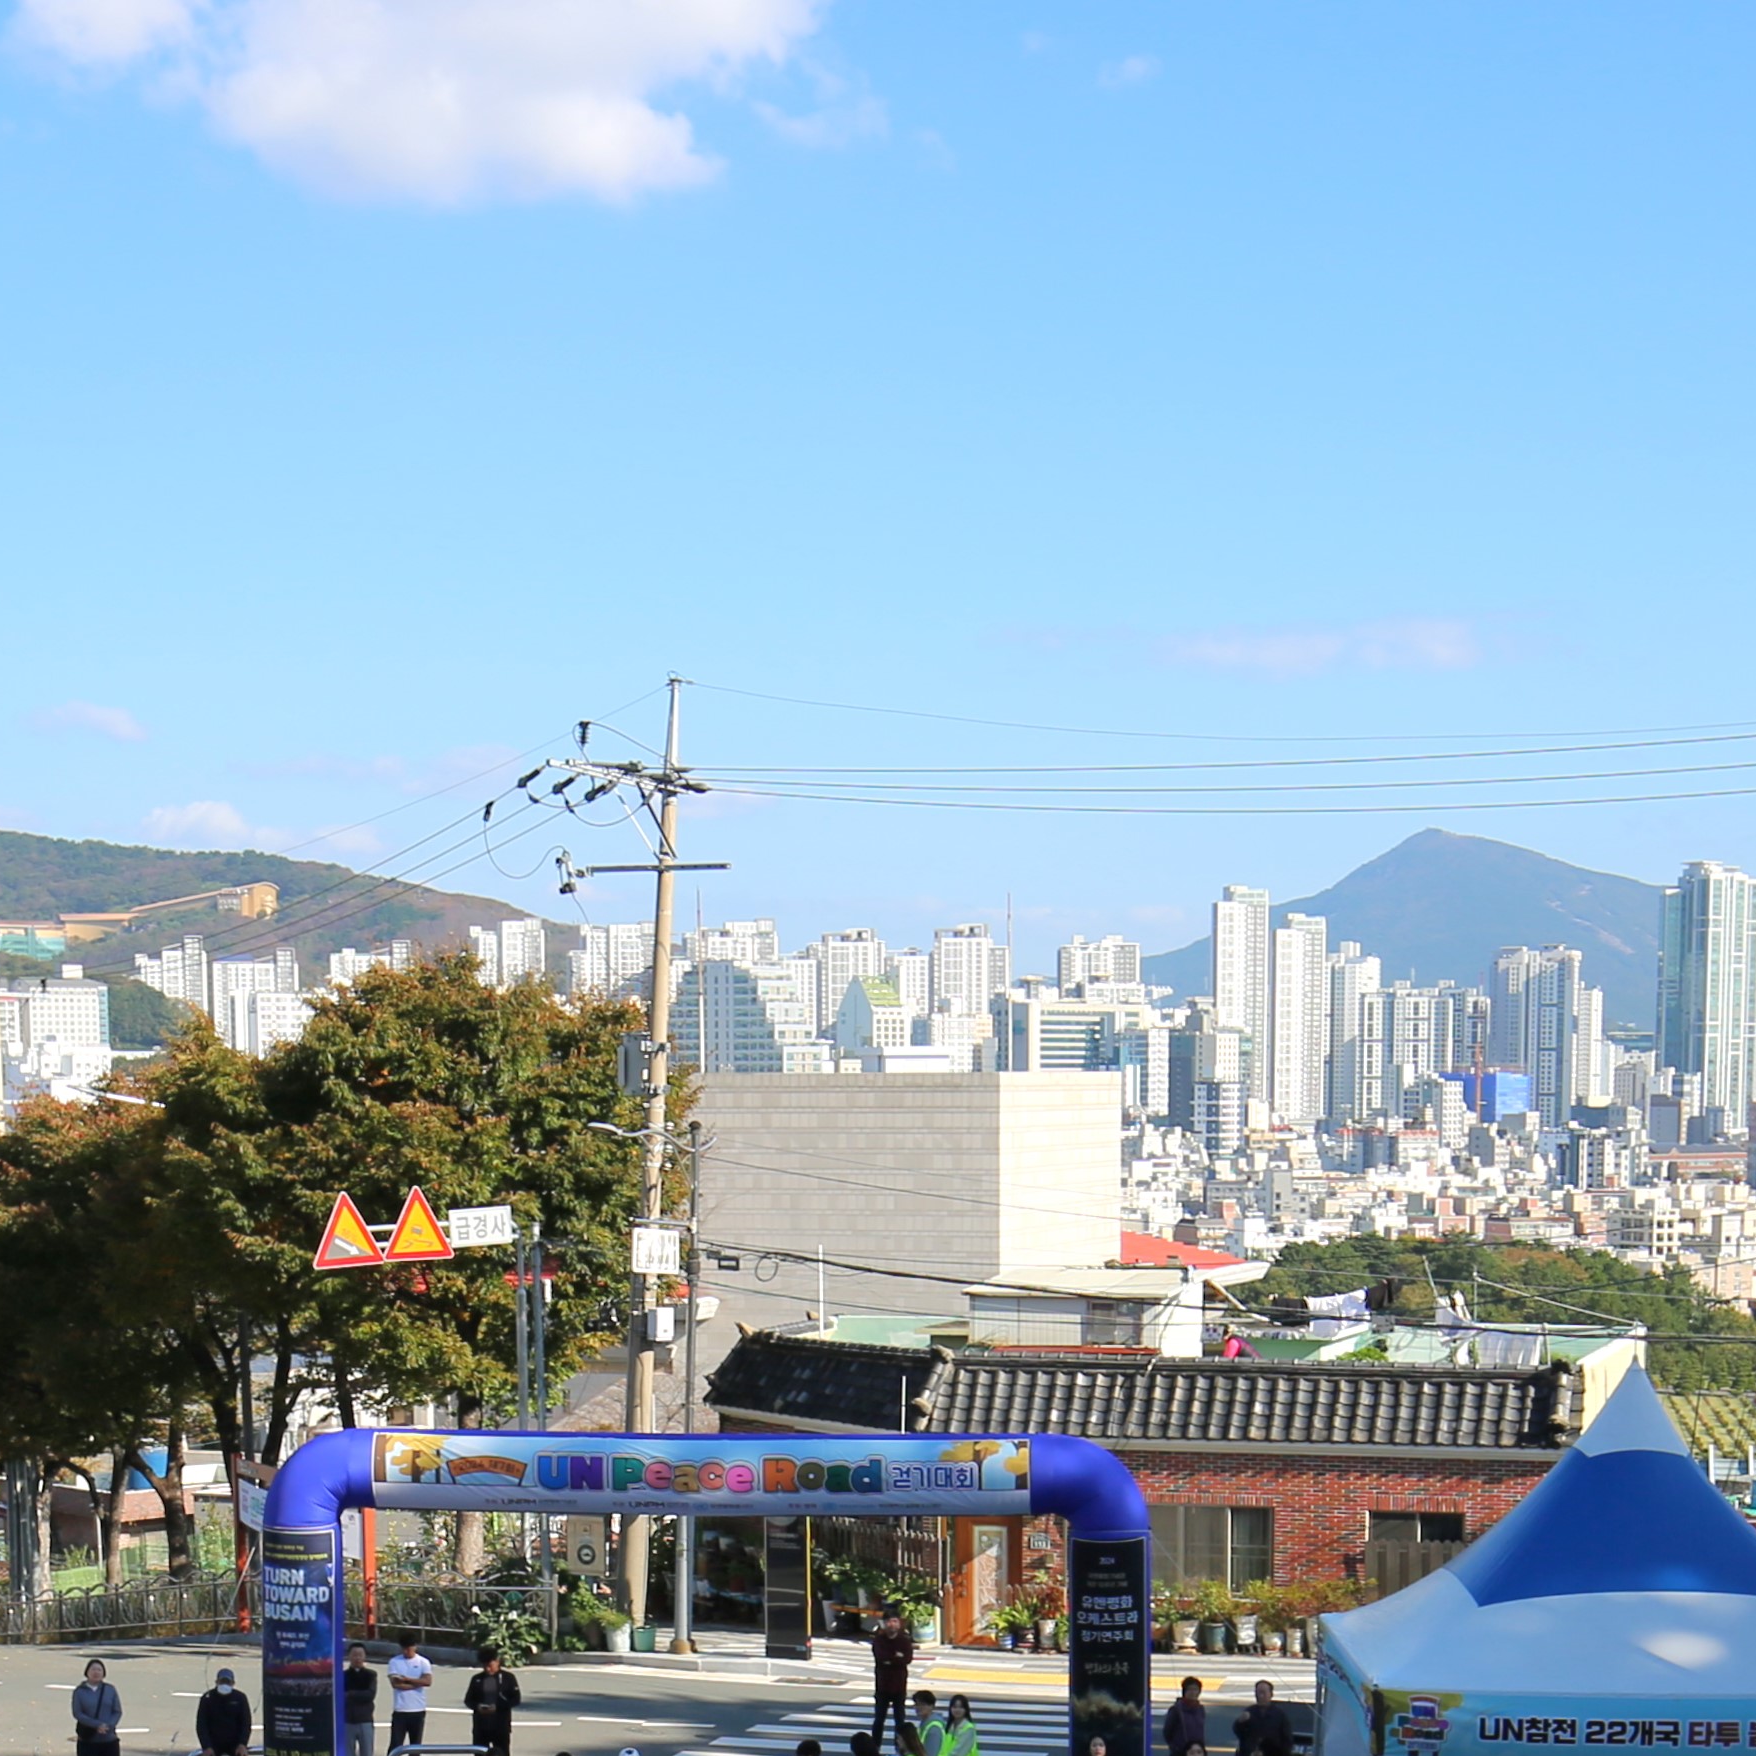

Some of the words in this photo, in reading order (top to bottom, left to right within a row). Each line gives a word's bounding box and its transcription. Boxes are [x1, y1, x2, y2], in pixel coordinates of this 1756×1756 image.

[455, 1213, 507, 1241] 급경사
[537, 1453, 604, 1491] UN
[610, 1453, 755, 1494] Peace
[762, 1455, 885, 1494] Road
[892, 1465, 974, 1490] 걷기대회
[264, 1566, 305, 1586] TURN
[265, 1584, 330, 1604] TOWARD
[1082, 1595, 1133, 1610] 유엔평화
[264, 1602, 317, 1621] BUSAN
[1076, 1611, 1139, 1625] 오케스트라
[1081, 1630, 1135, 1642] 정기연주회
[1479, 1718, 1577, 1743] UN참전
[1584, 1720, 1680, 1746] 22개국
[1687, 1721, 1740, 1746] 타투
